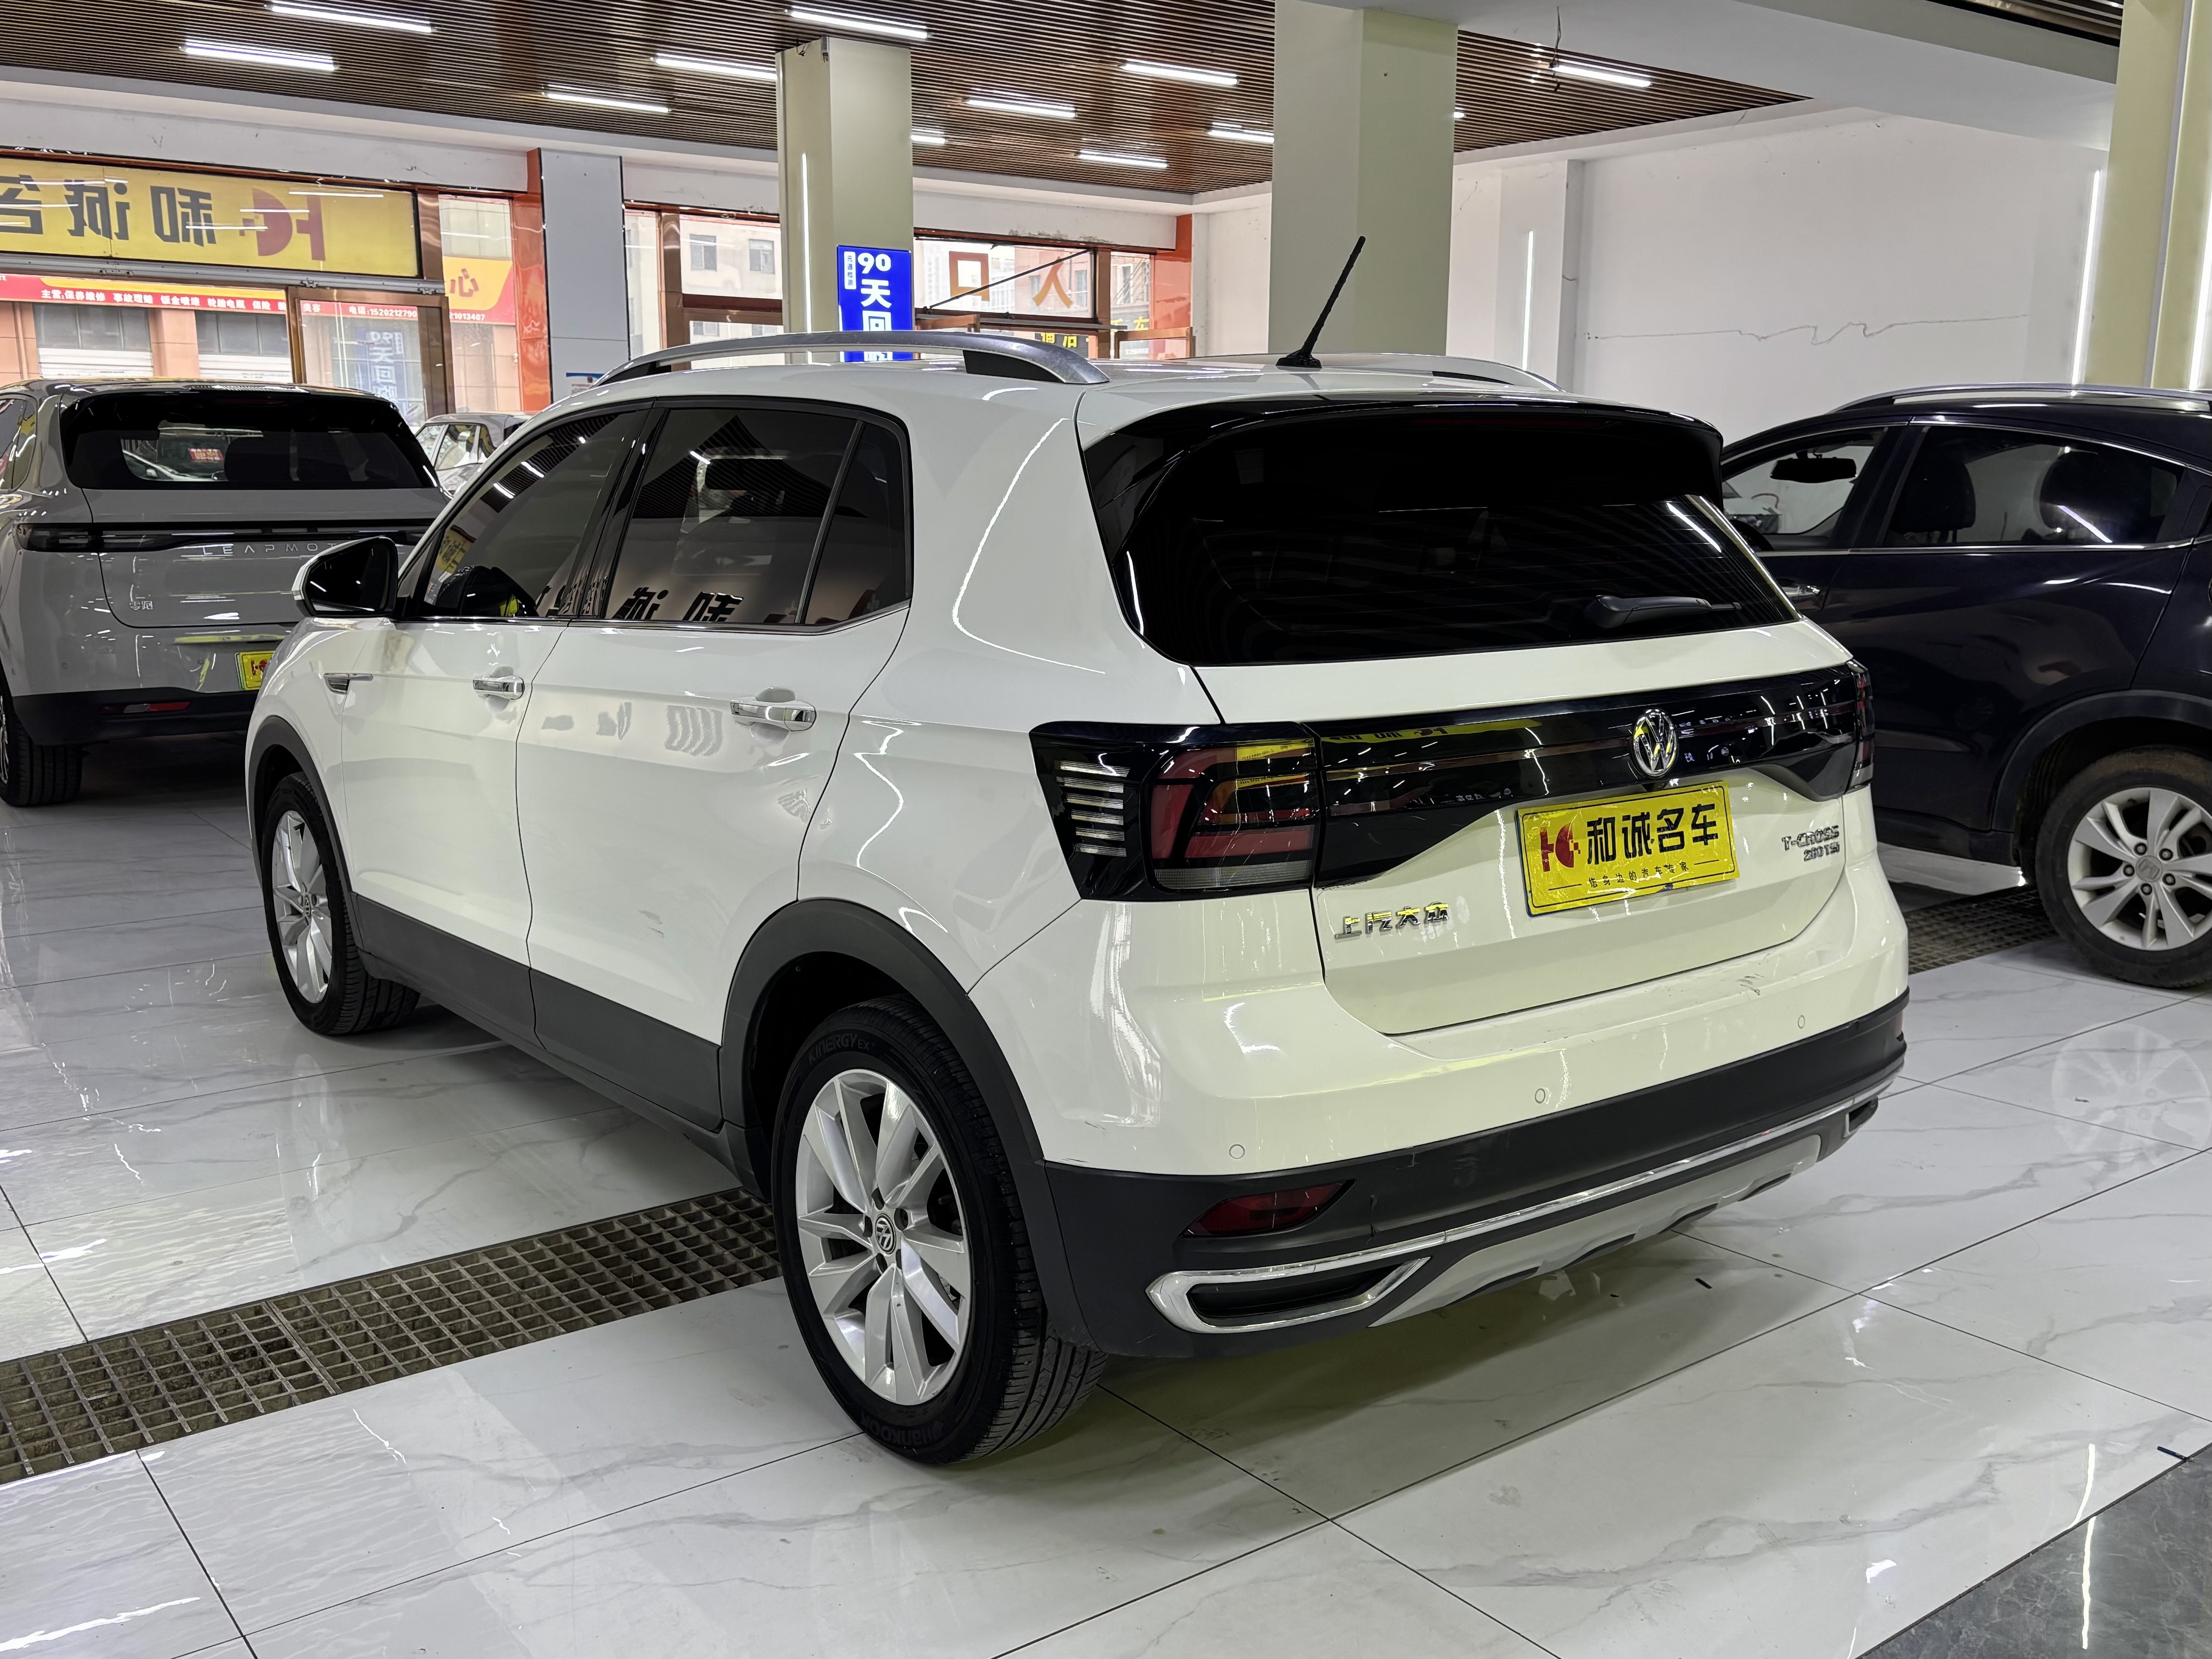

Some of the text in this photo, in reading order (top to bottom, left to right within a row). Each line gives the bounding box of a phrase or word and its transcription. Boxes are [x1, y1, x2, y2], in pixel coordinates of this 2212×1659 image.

[450, 268, 479, 297] 心
[857, 252, 893, 361] 90天回
[1587, 803, 1719, 865] 和诚名车
[1334, 901, 1449, 939] 上汽大众
